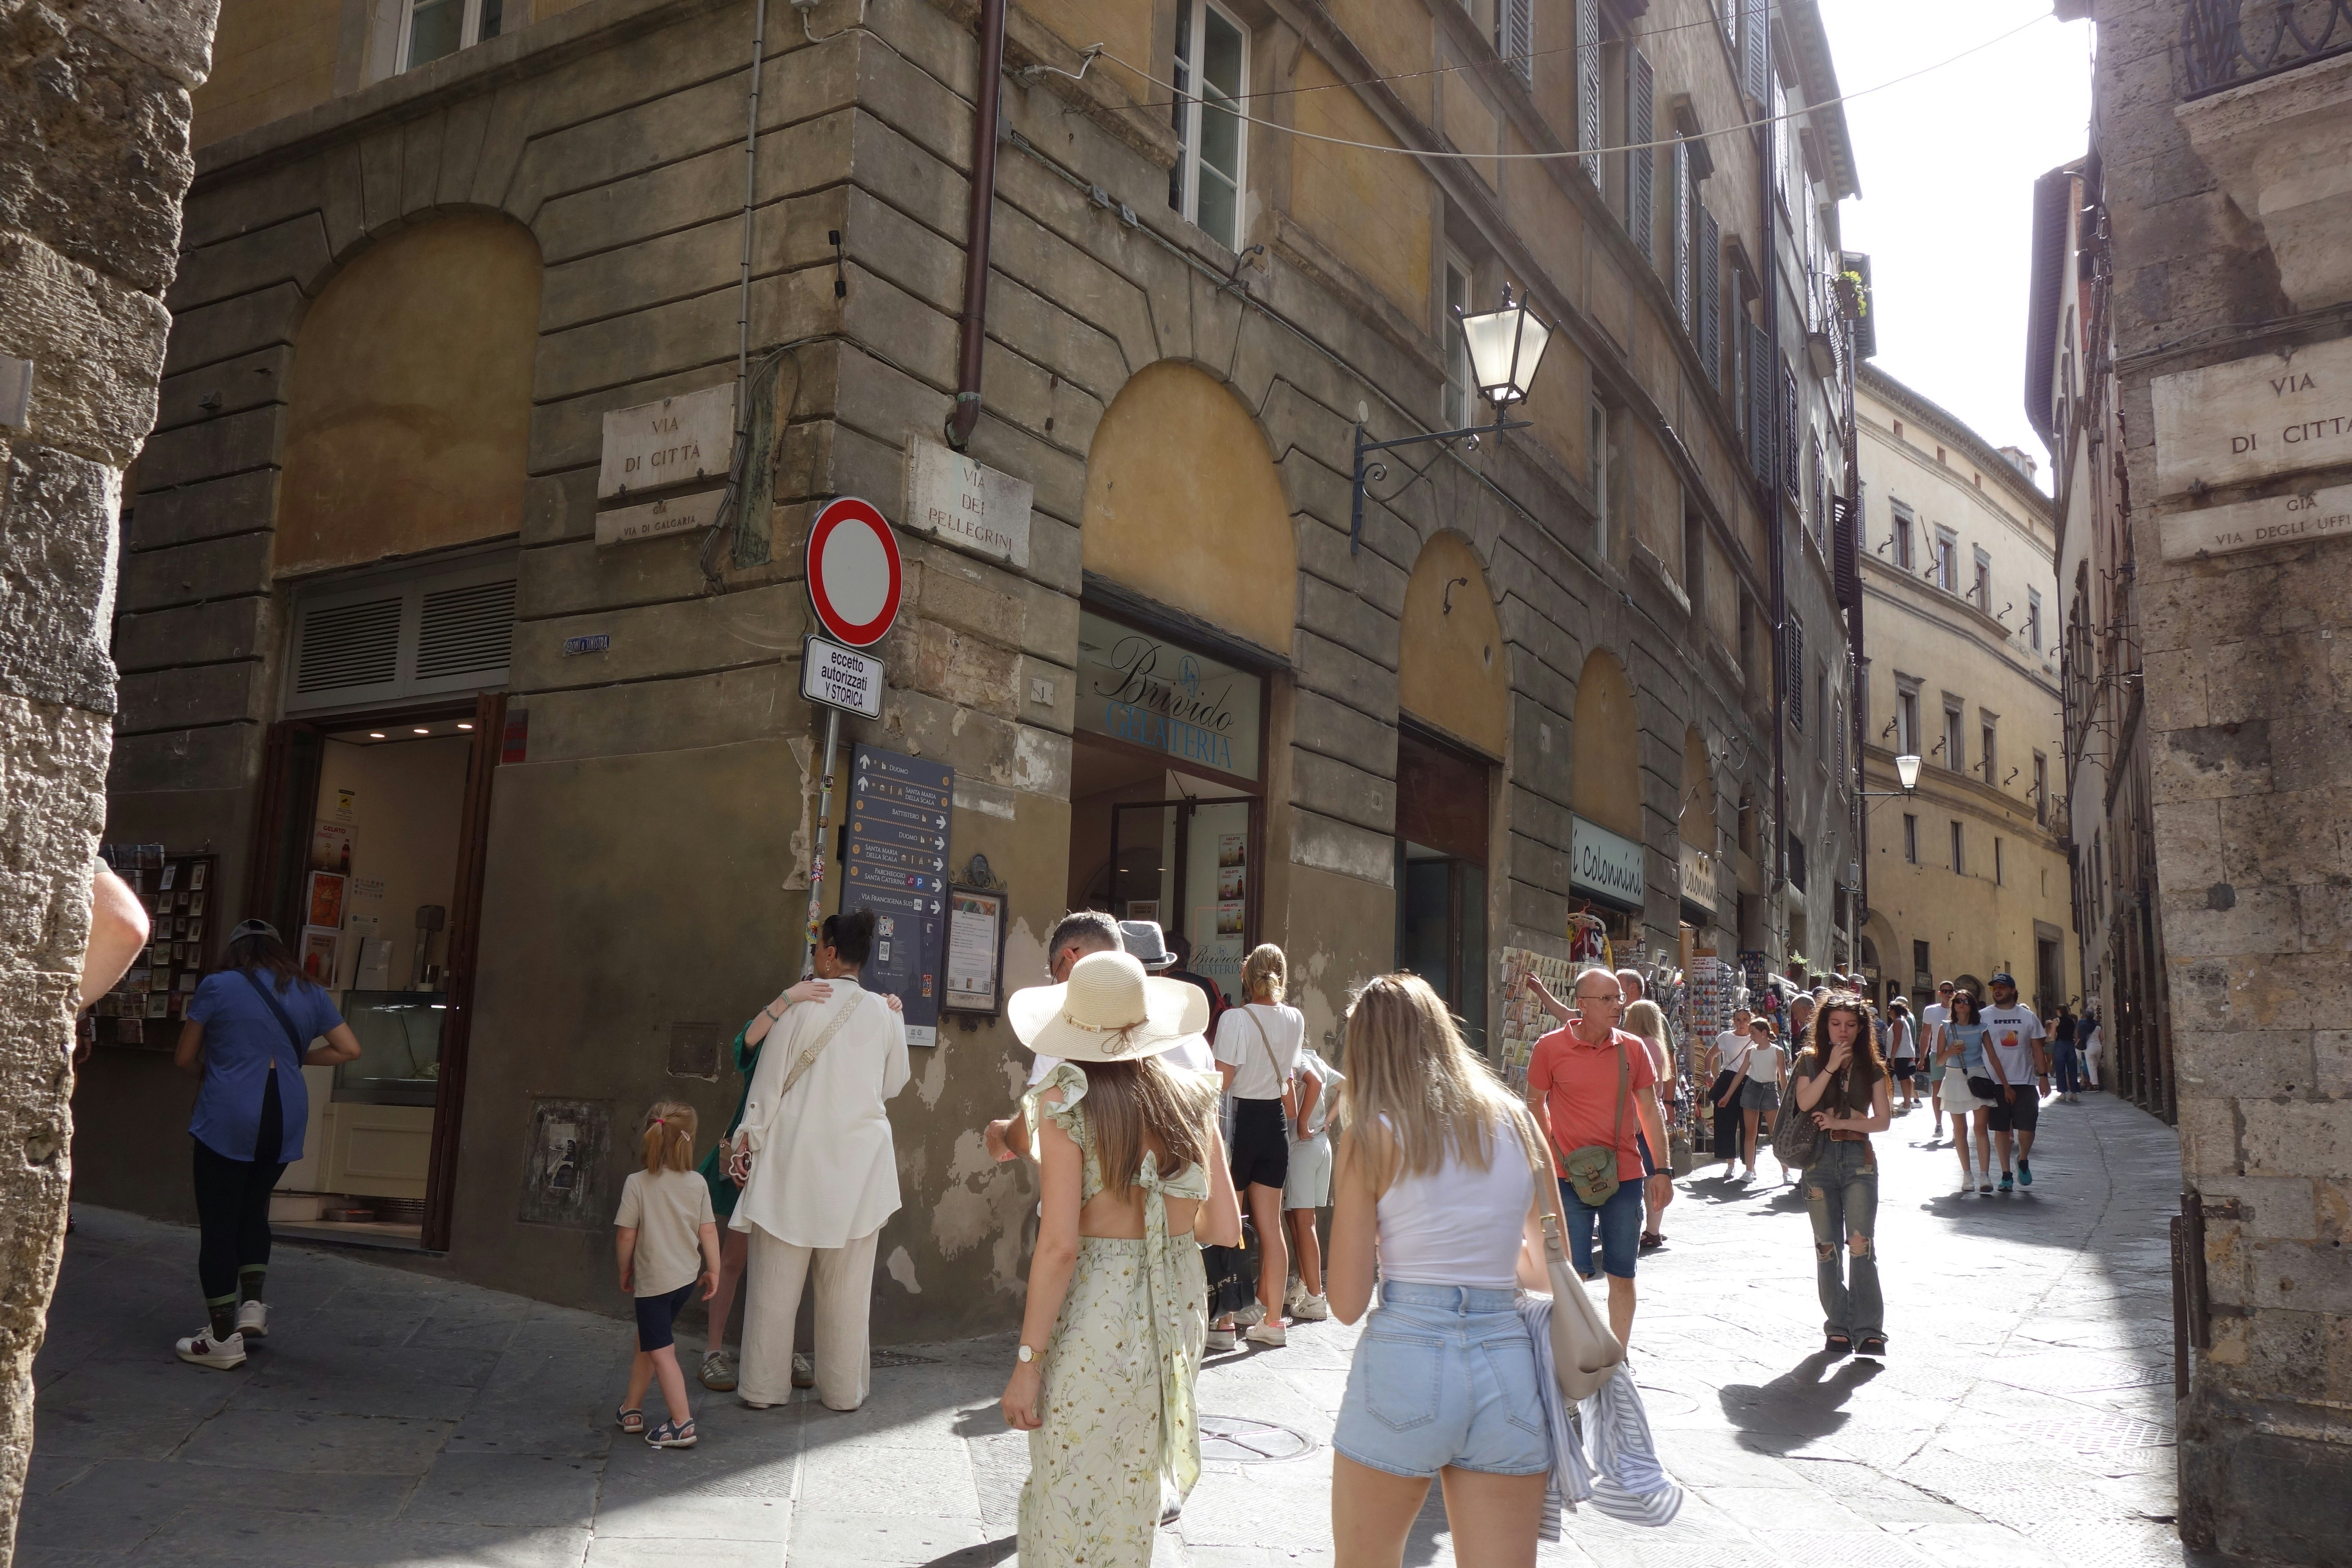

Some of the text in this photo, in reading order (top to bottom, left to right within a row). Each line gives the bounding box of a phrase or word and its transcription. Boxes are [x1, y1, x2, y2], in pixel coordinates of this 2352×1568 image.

[2269, 373, 2316, 398] VIA
[652, 416, 678, 434] VIA
[2231, 433, 2257, 454] DI
[625, 440, 700, 472] DI CITTÀ
[963, 467, 986, 491] VIA
[962, 493, 984, 515] DEI
[624, 515, 695, 536] VIA DI GALGARIA
[929, 507, 1012, 551] PELLEGRINI
[2216, 533, 2243, 546] VIA
[2255, 521, 2305, 540] DEGLI
[564, 640, 581, 652] EDONI
[585, 636, 607, 650] SINISTRA
[831, 652, 864, 673] eccetto
[821, 666, 867, 691] autorizzati
[1094, 636, 1234, 731] Brivido
[825, 682, 863, 708] Y STORICA
[1041, 686, 1044, 698] 1
[1106, 701, 1232, 769] GELATERIA
[889, 765, 908, 775] DUOMO
[905, 787, 920, 796] SANTA
[921, 790, 936, 799] MARIA
[905, 794, 934, 806] DELLA SCALA
[892, 808, 919, 820] BATTISTERO
[323, 825, 346, 834] GELATO
[898, 832, 918, 841] DUOMO
[865, 844, 897, 856] SANTA MARIA
[882, 854, 897, 863] SCALA
[1573, 828, 1642, 897] i Colonnini
[864, 873, 922, 886] SANTA CATERINA P
[874, 868, 906, 879] PARCHEGGIO
[1685, 863, 1717, 903] Colonnini
[871, 894, 902, 905] FRANCIGENA
[1188, 945, 1241, 965] Brivido
[1188, 965, 1240, 974] GELATERIA
